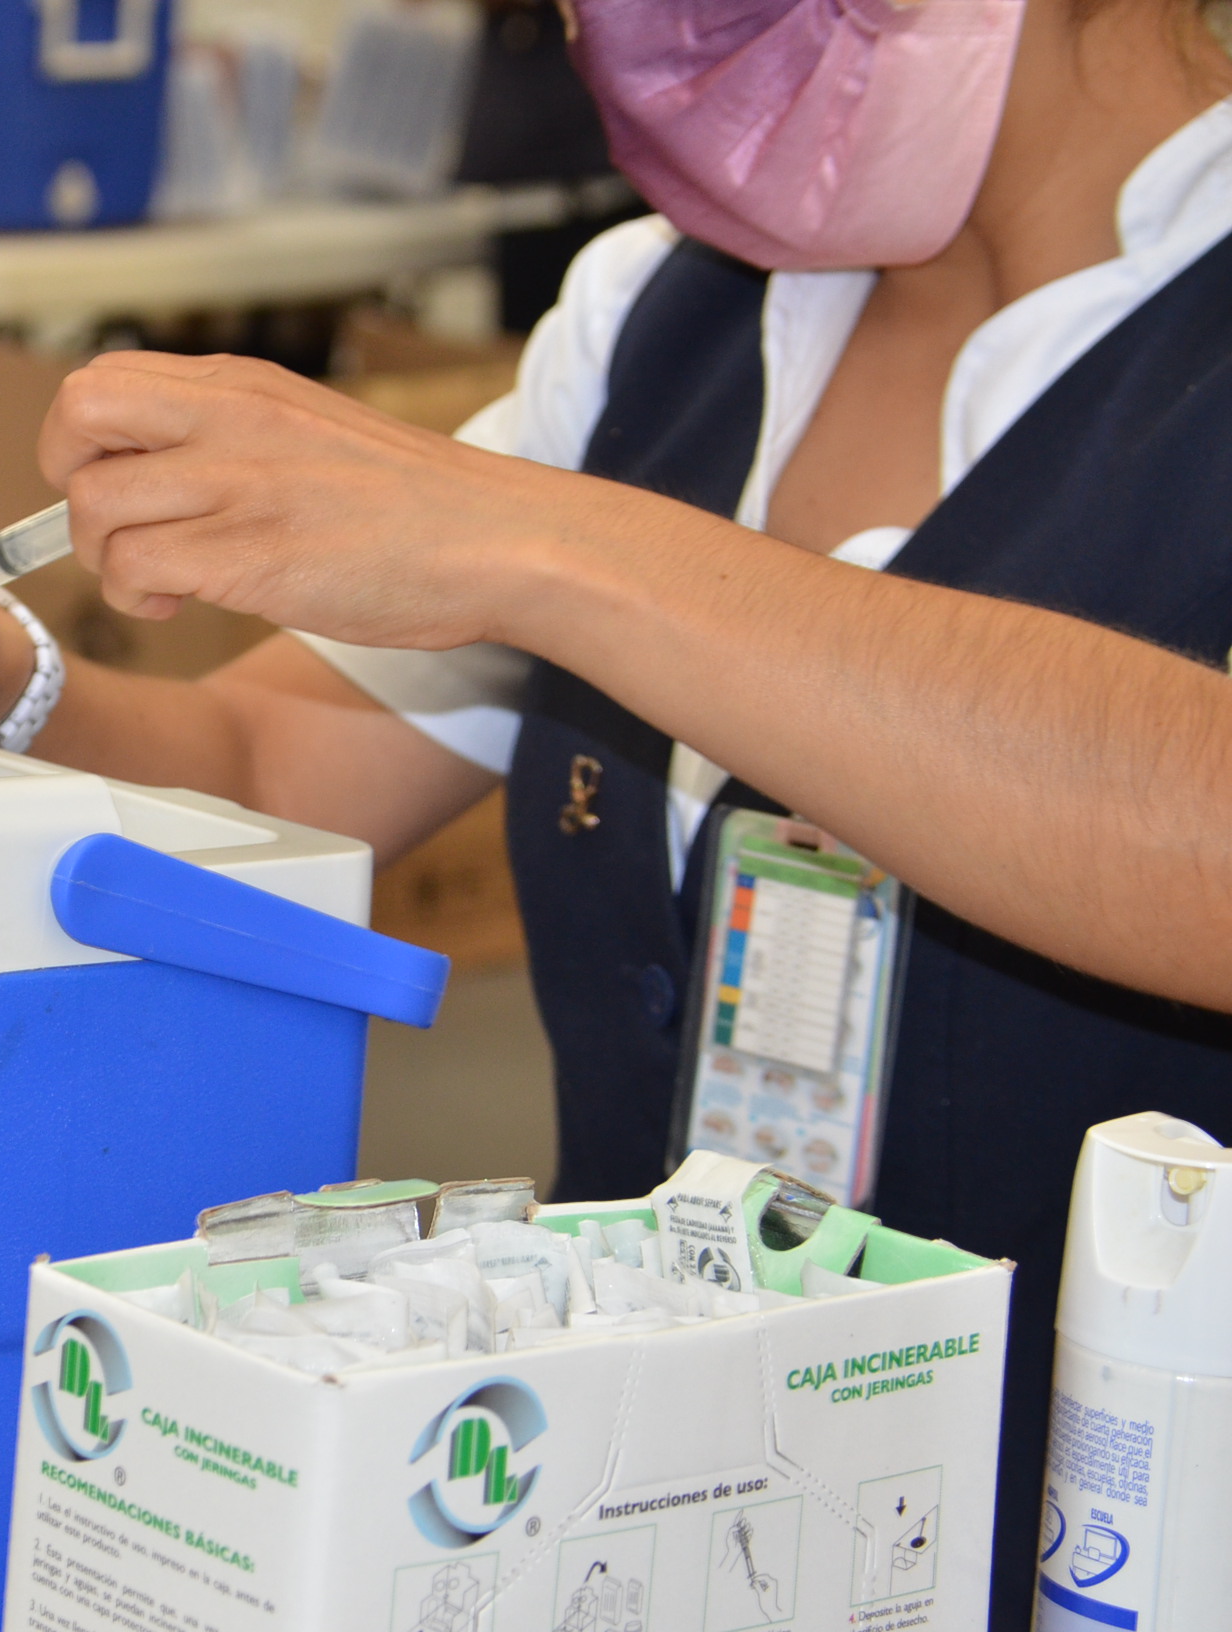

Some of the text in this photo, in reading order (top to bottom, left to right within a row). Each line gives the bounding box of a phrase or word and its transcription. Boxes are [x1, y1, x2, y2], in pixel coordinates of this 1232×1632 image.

[786, 1332, 980, 1390] CAJA INCINERABLE
[831, 1369, 934, 1403] CON JERINGAS
[1084, 1406, 1118, 1426] superficies
[1129, 1419, 1154, 1436] medio
[141, 1406, 299, 1488] CAJA INCINERABLE
[174, 1445, 257, 1490] CON JERINGAS
[1132, 1471, 1150, 1483] para
[598, 1477, 768, 1520] Instrucciones de uso:
[1106, 1486, 1131, 1503] donde
[1134, 1496, 1148, 1507] sea
[36, 1510, 62, 1530] utilizar
[64, 1522, 81, 1540] este
[41, 1460, 256, 1574] RECOMENDACIONES BÁSICAS:
[1091, 1507, 1114, 1525] ESCUELA
[46, 1543, 62, 1562] Esta
[122, 1584, 155, 1608] permite
[74, 1513, 116, 1540] instructivo
[118, 1533, 129, 1546] de
[151, 1550, 186, 1574] impreso
[188, 1568, 200, 1580] en
[235, 1590, 260, 1608] antes
[32, 1571, 57, 1592] cuenta
[858, 1606, 893, 1622] Deposite
[903, 1599, 922, 1613] aguja
[924, 1598, 934, 1607] en
